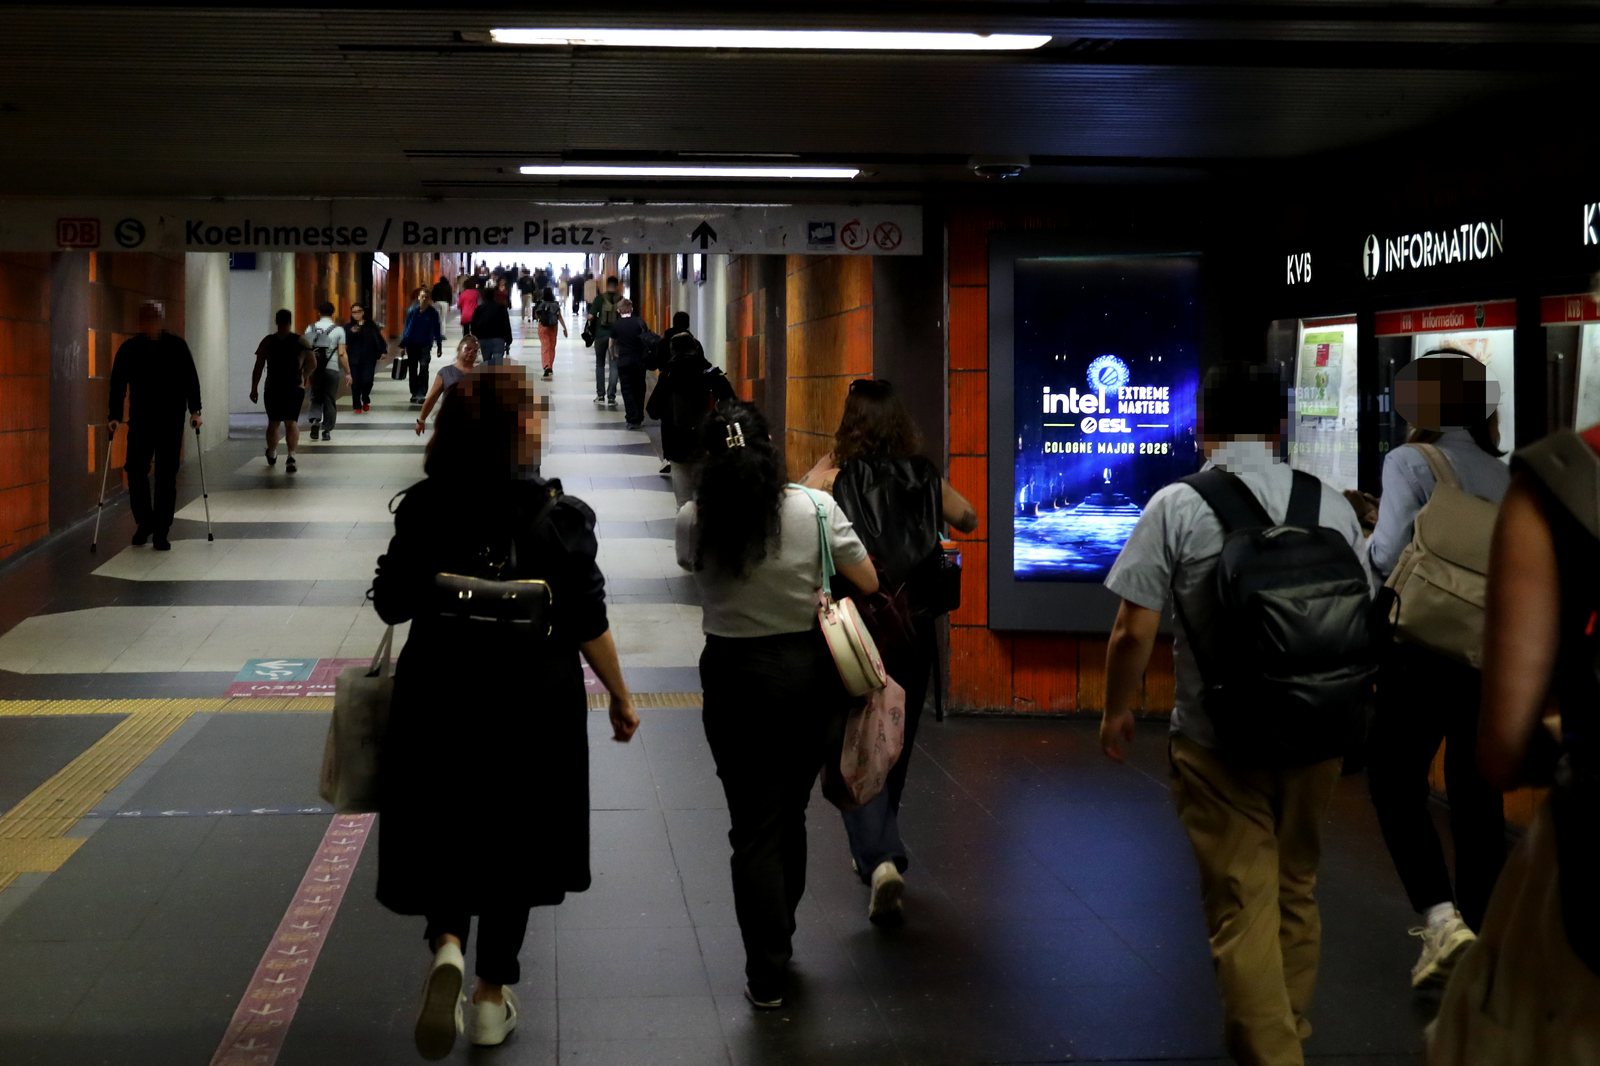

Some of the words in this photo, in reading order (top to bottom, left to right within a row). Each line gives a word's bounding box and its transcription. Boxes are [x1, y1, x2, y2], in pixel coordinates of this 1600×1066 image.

[59, 219, 98, 246] DB
[185, 219, 368, 246] Koelnmesse
[376, 218, 393, 250] /
[402, 220, 513, 246] Barmer
[523, 219, 594, 246] Platz
[1384, 218, 1504, 273] INFORMATION
[1286, 251, 1312, 285] KVB
[1421, 308, 1465, 330] Information
[1118, 386, 1169, 400] EXTREME
[1118, 401, 1169, 414] MASTERS
[1098, 418, 1132, 433] ESL
[1044, 441, 1093, 454] COLOGNE
[1098, 442, 1135, 454] MAJOR
[1139, 442, 1168, 455] 2026
